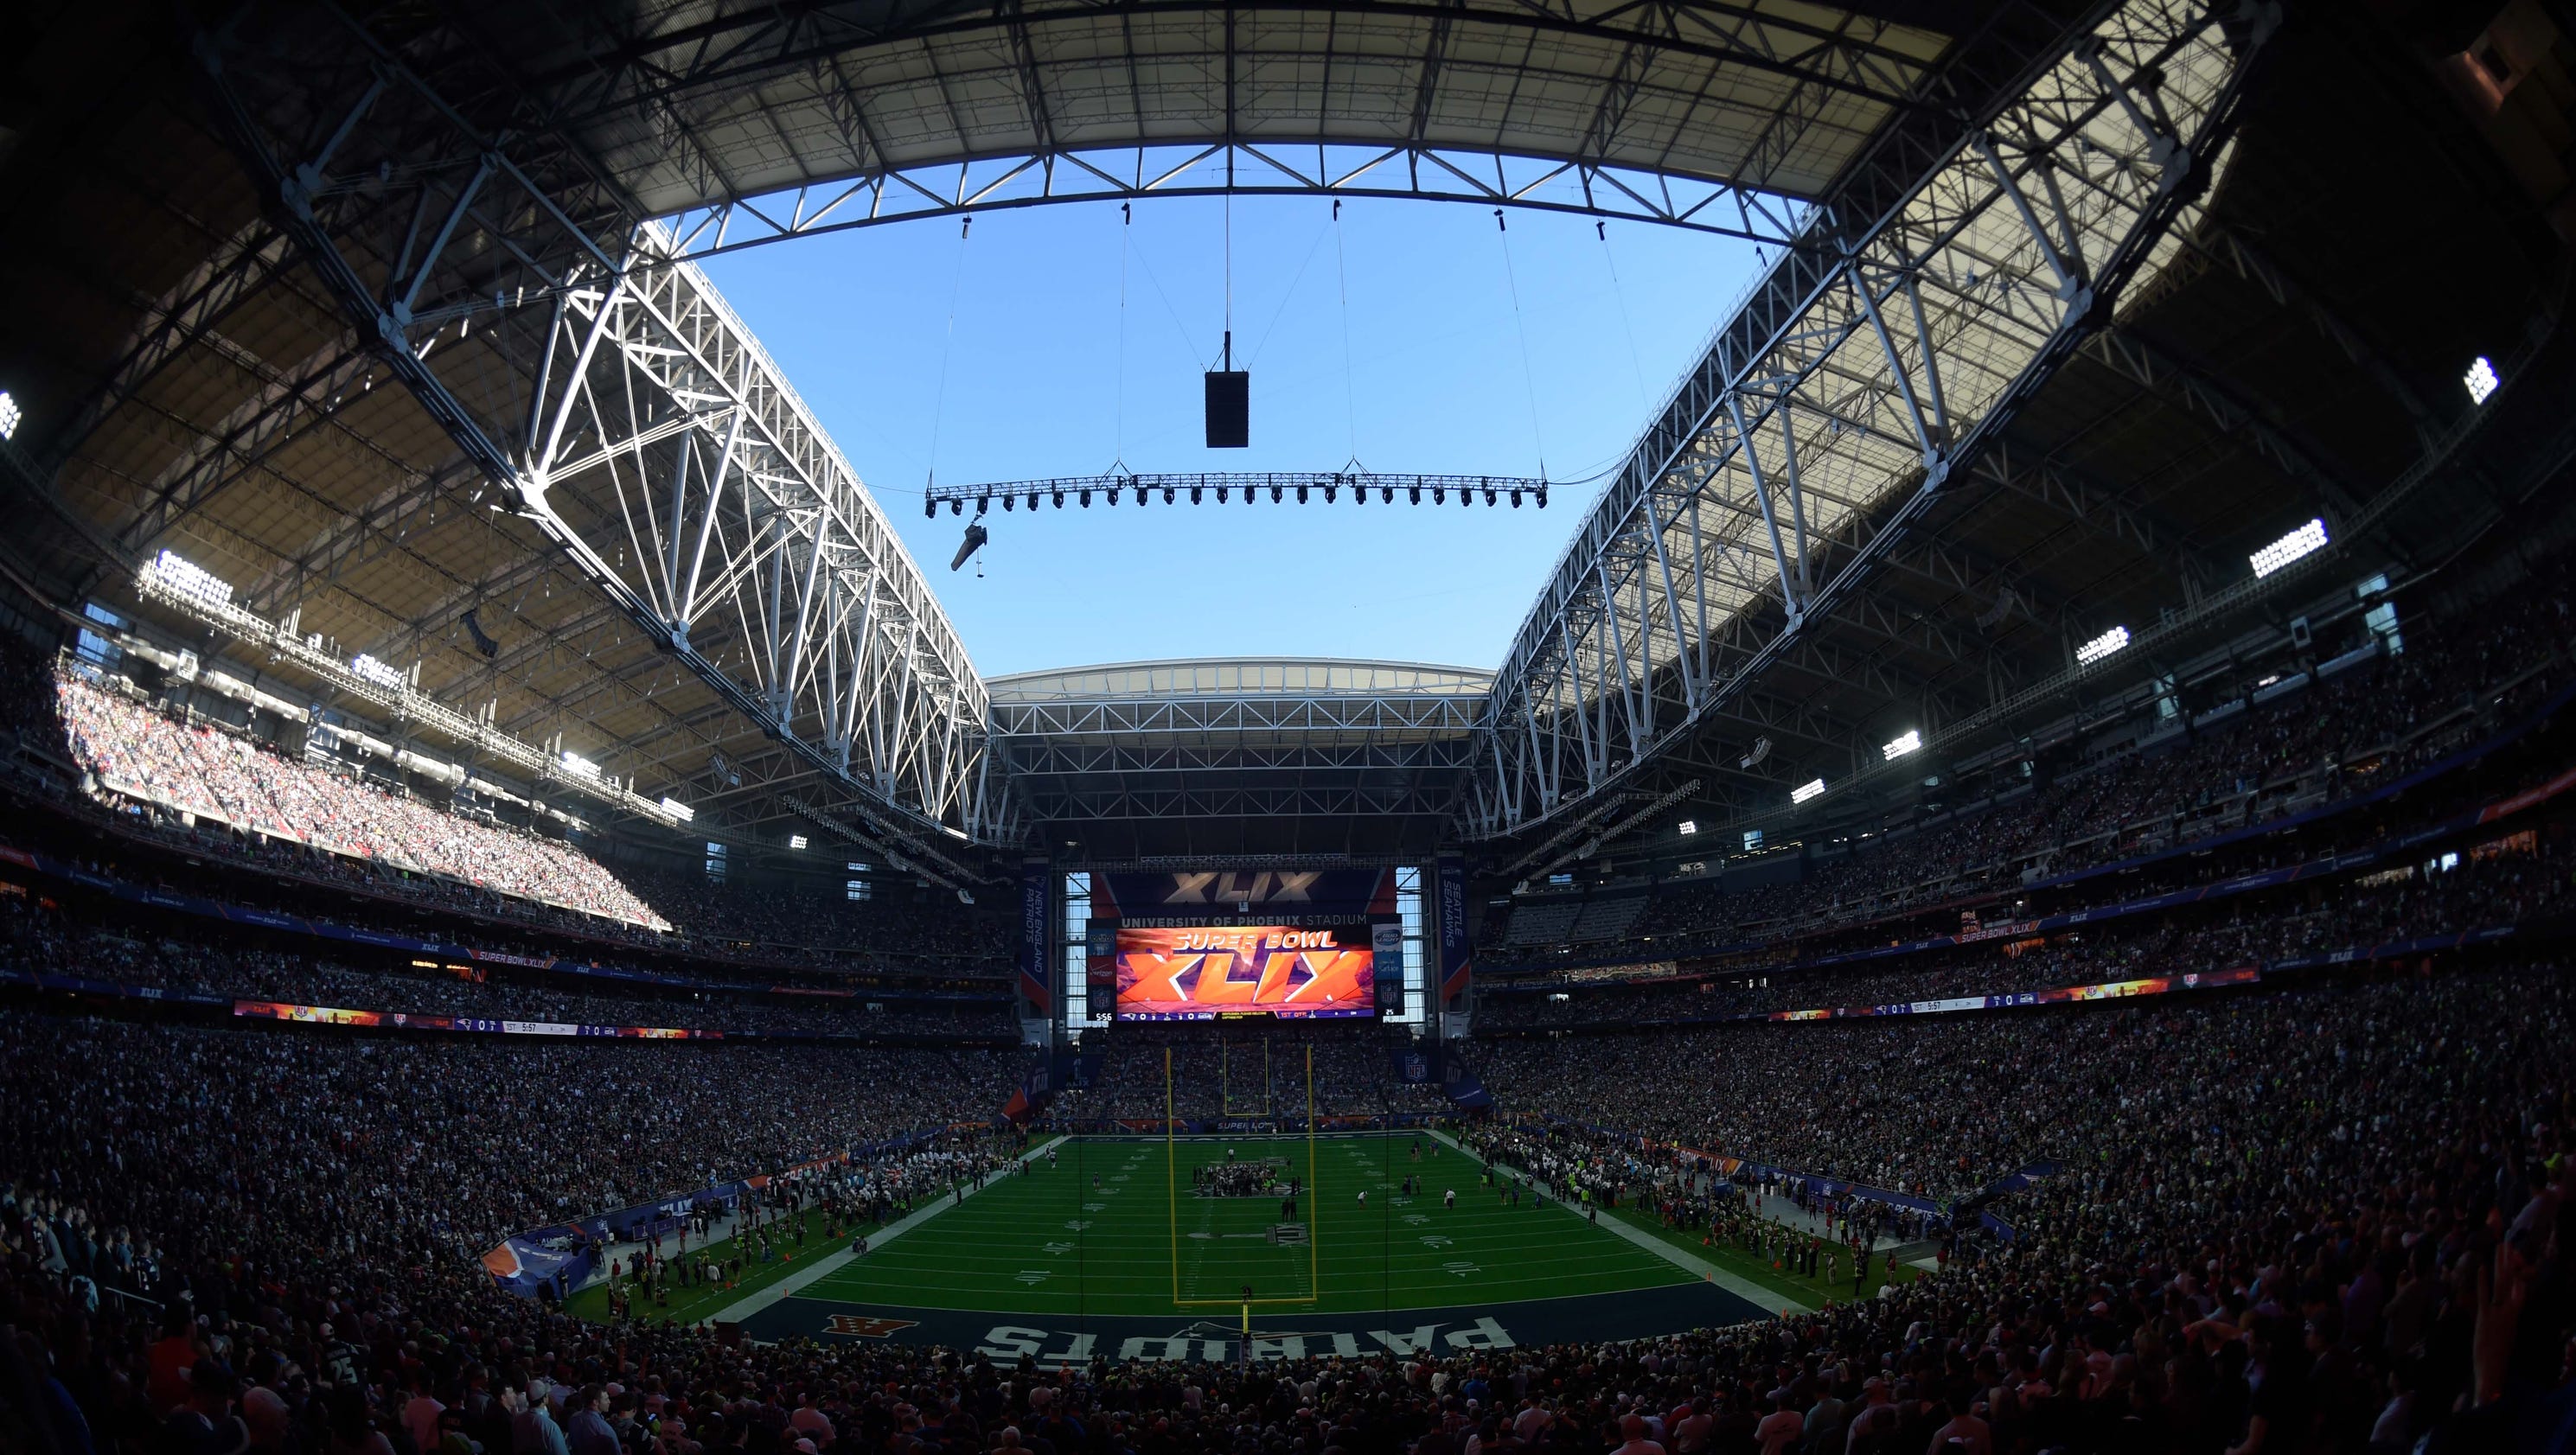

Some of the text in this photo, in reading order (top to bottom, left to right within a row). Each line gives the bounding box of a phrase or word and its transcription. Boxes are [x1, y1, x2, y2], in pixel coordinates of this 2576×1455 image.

[1163, 871, 1323, 903] XLIX
[1026, 887, 1034, 943] PATRIOTS
[1443, 879, 1454, 948] SEAHAWKS
[1453, 883, 1463, 937] SEATTLE
[1122, 915, 1367, 929] UNIVERSITY OF PHOENIX STADIUM
[1033, 890, 1044, 973] NEW ENGLAND
[1961, 922, 2031, 943] SUPER BOWL XLIX
[1171, 929, 1339, 951] SUPER BOWL
[479, 951, 546, 969] SUPER BOWL XLIX
[1122, 950, 1371, 1005] XLIX
[1927, 1001, 1941, 1011] 5:57
[2006, 995, 2013, 1006] 0
[1096, 1012, 1113, 1022] 5:56
[1140, 1012, 1147, 1021] 0
[1891, 1005, 1897, 1014] 0
[478, 1020, 485, 1031] 0
[521, 1023, 537, 1032] 5:57
[593, 1026, 600, 1036] 0
